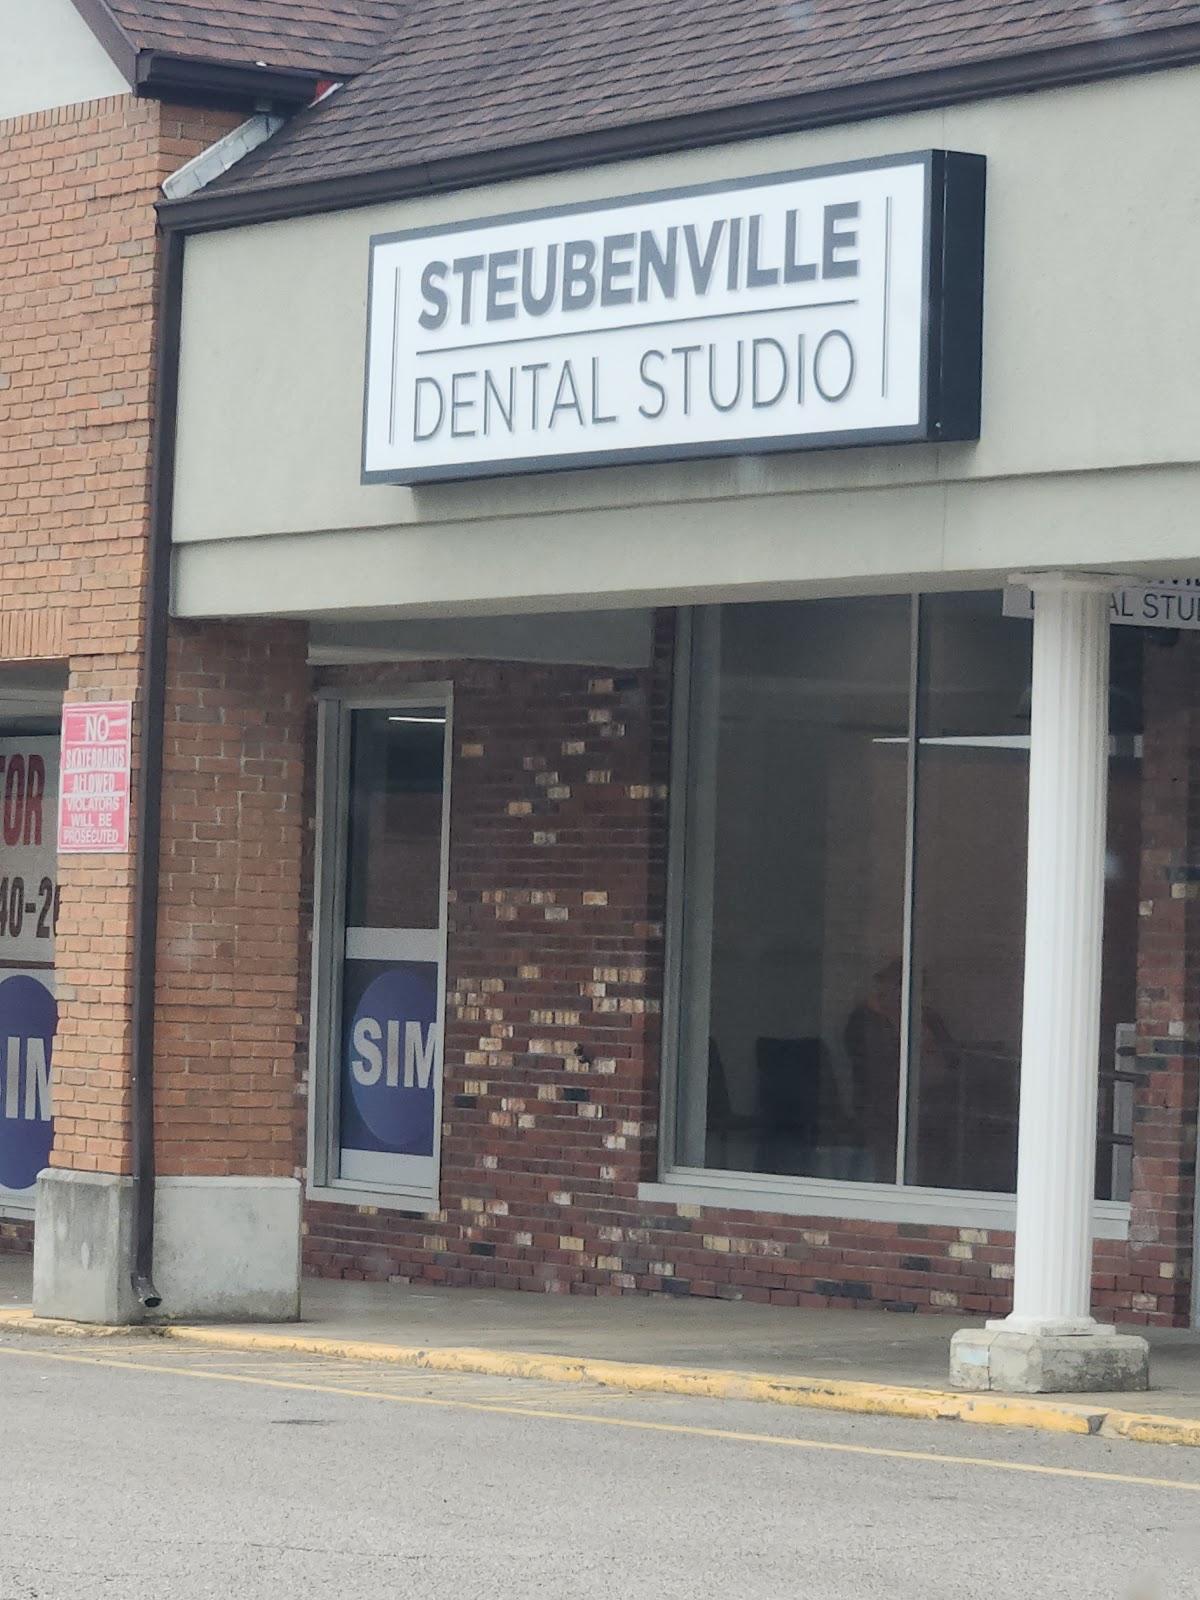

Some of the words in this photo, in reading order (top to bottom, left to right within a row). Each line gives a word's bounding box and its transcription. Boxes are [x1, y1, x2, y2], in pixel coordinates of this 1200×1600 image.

[417, 200, 860, 331] STEUBENVILLE
[413, 357, 617, 442] DENTAL
[638, 329, 856, 419] STUDIO
[1143, 593, 1200, 621] STU
[85, 713, 110, 742] NO
[66, 747, 125, 769] SKATEBOARDS
[72, 773, 115, 793] ALLOWED
[66, 797, 120, 811] VIOLATORS
[71, 813, 94, 827] WILL
[98, 812, 113, 826] BE
[63, 829, 119, 844] PROSECUTED
[352, 1017, 437, 1088] SIM
